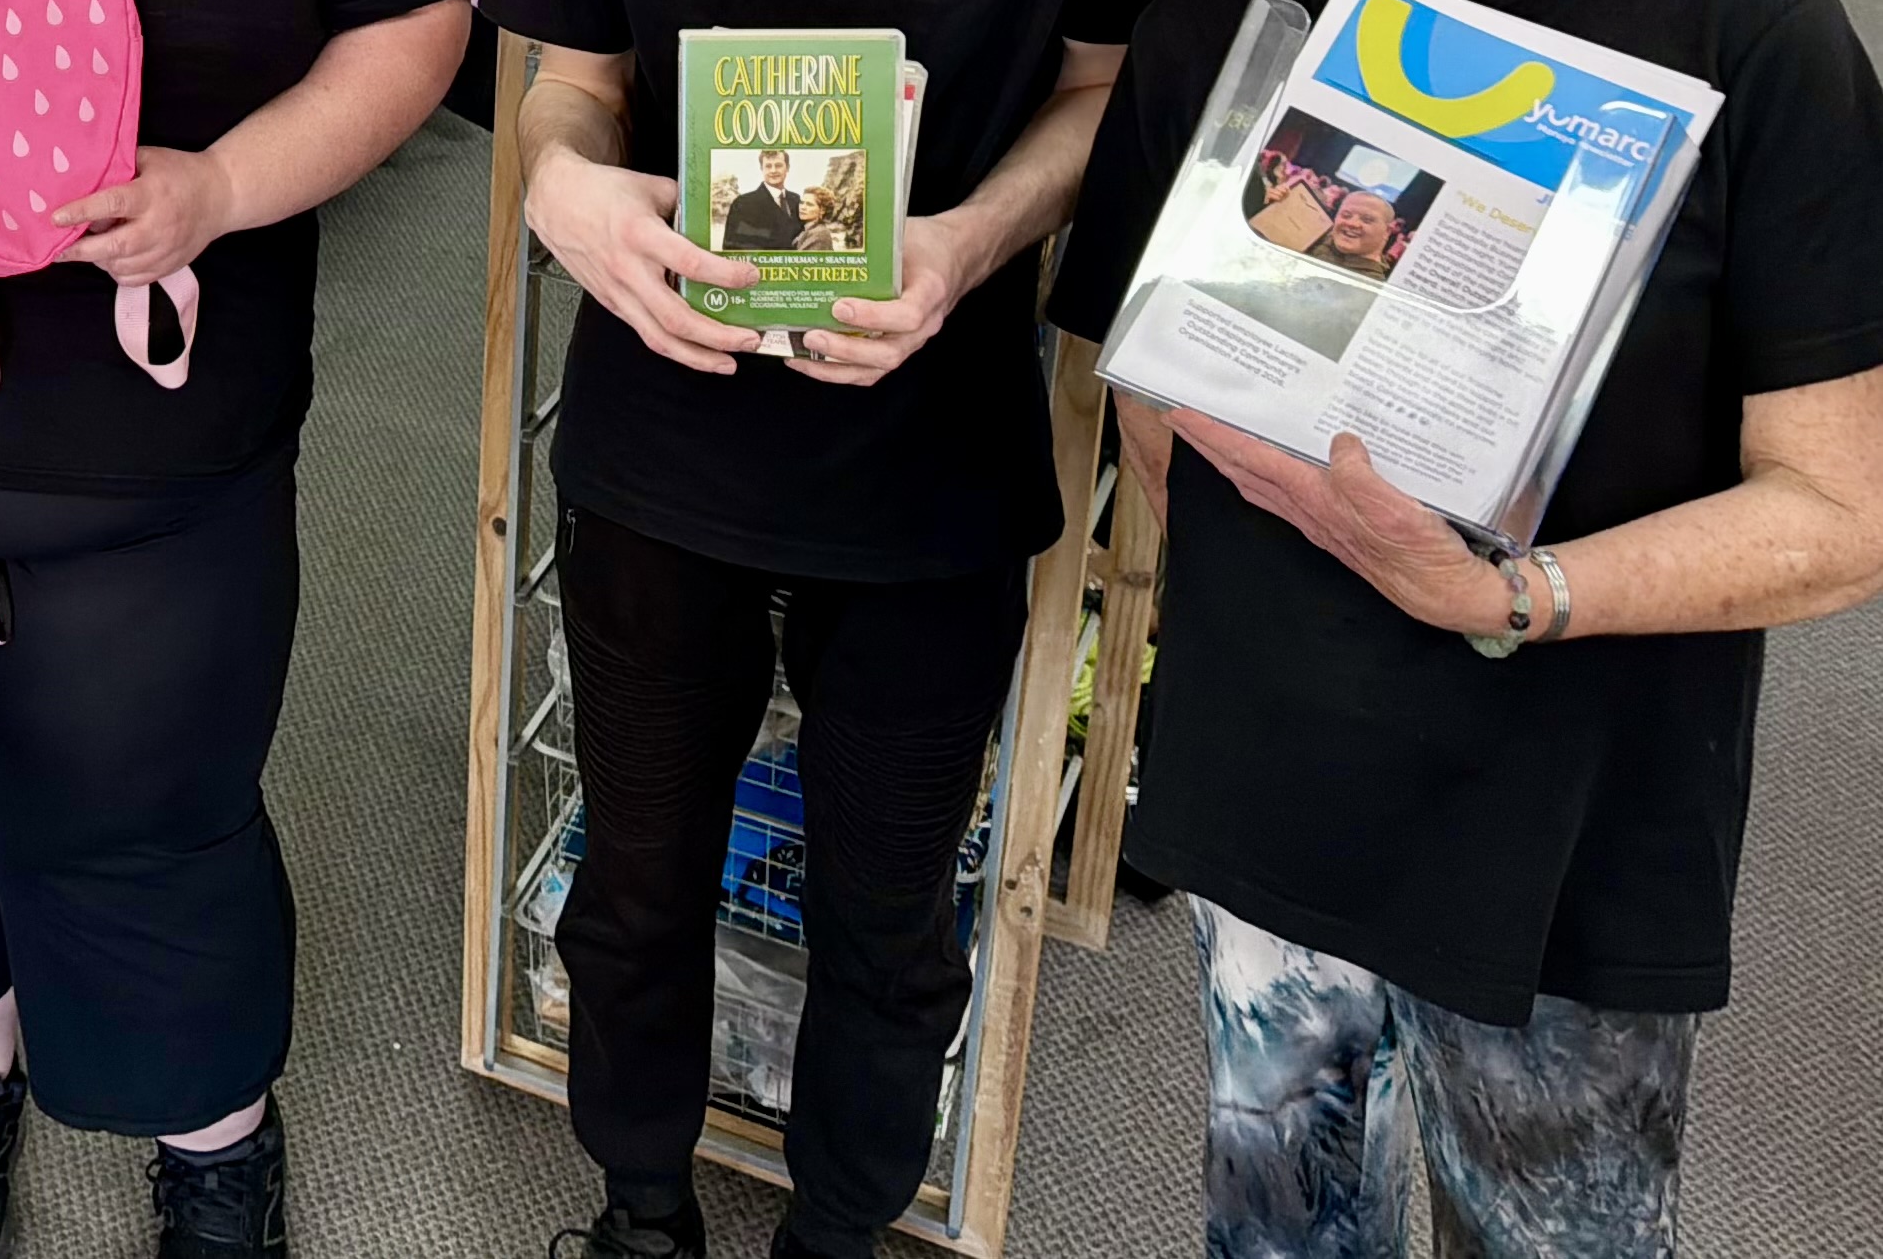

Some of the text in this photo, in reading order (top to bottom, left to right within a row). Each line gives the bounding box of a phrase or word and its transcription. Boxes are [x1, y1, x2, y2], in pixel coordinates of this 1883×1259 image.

[714, 55, 862, 96] CATHERINE
[714, 99, 862, 146] COOKSON
[759, 256, 784, 264] CLARE
[785, 256, 818, 264] HOLMAN
[847, 256, 867, 264] BEAN
[761, 267, 868, 282] TEEN STREETS
[710, 294, 746, 306] M 15+
